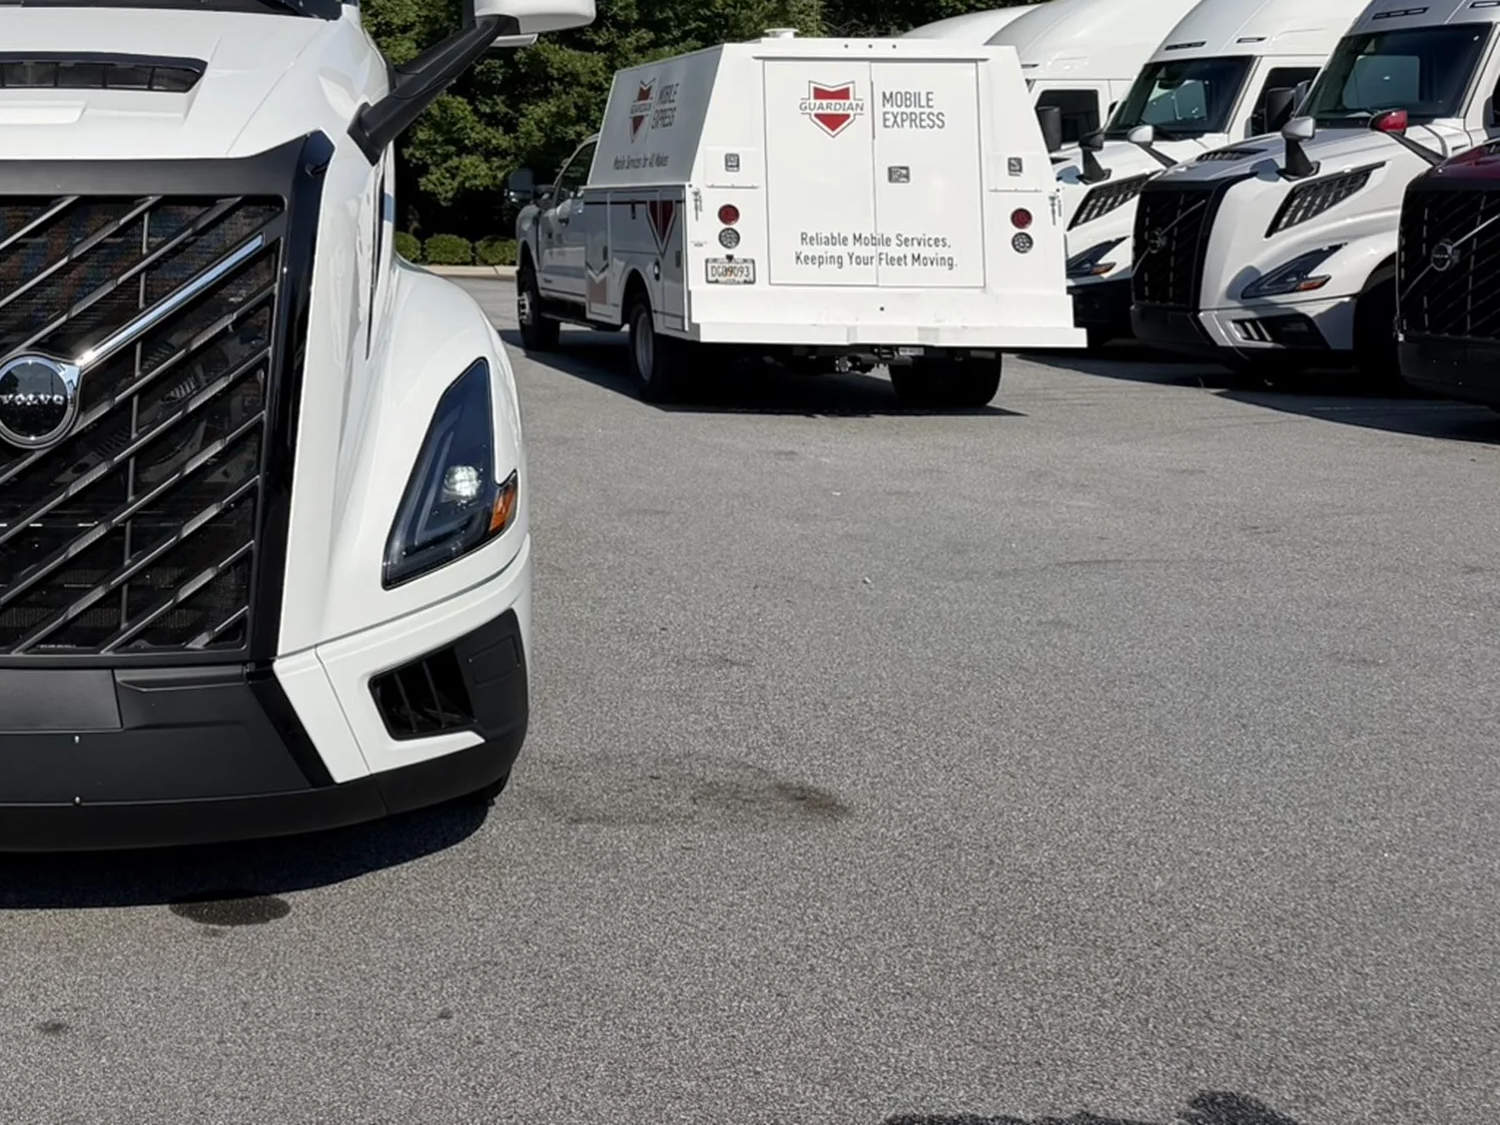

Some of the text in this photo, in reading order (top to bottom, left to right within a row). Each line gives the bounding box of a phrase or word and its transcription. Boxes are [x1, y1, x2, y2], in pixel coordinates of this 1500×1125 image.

[799, 101, 864, 112] GUARDIAN
[882, 91, 934, 108] MOBILE
[882, 111, 945, 129] EXPRESS
[800, 232, 848, 247] Reliable
[852, 233, 892, 247] Mobile
[795, 251, 958, 271] Keeping Your Fleet Moving.
[0, 394, 65, 406] VOLVO
